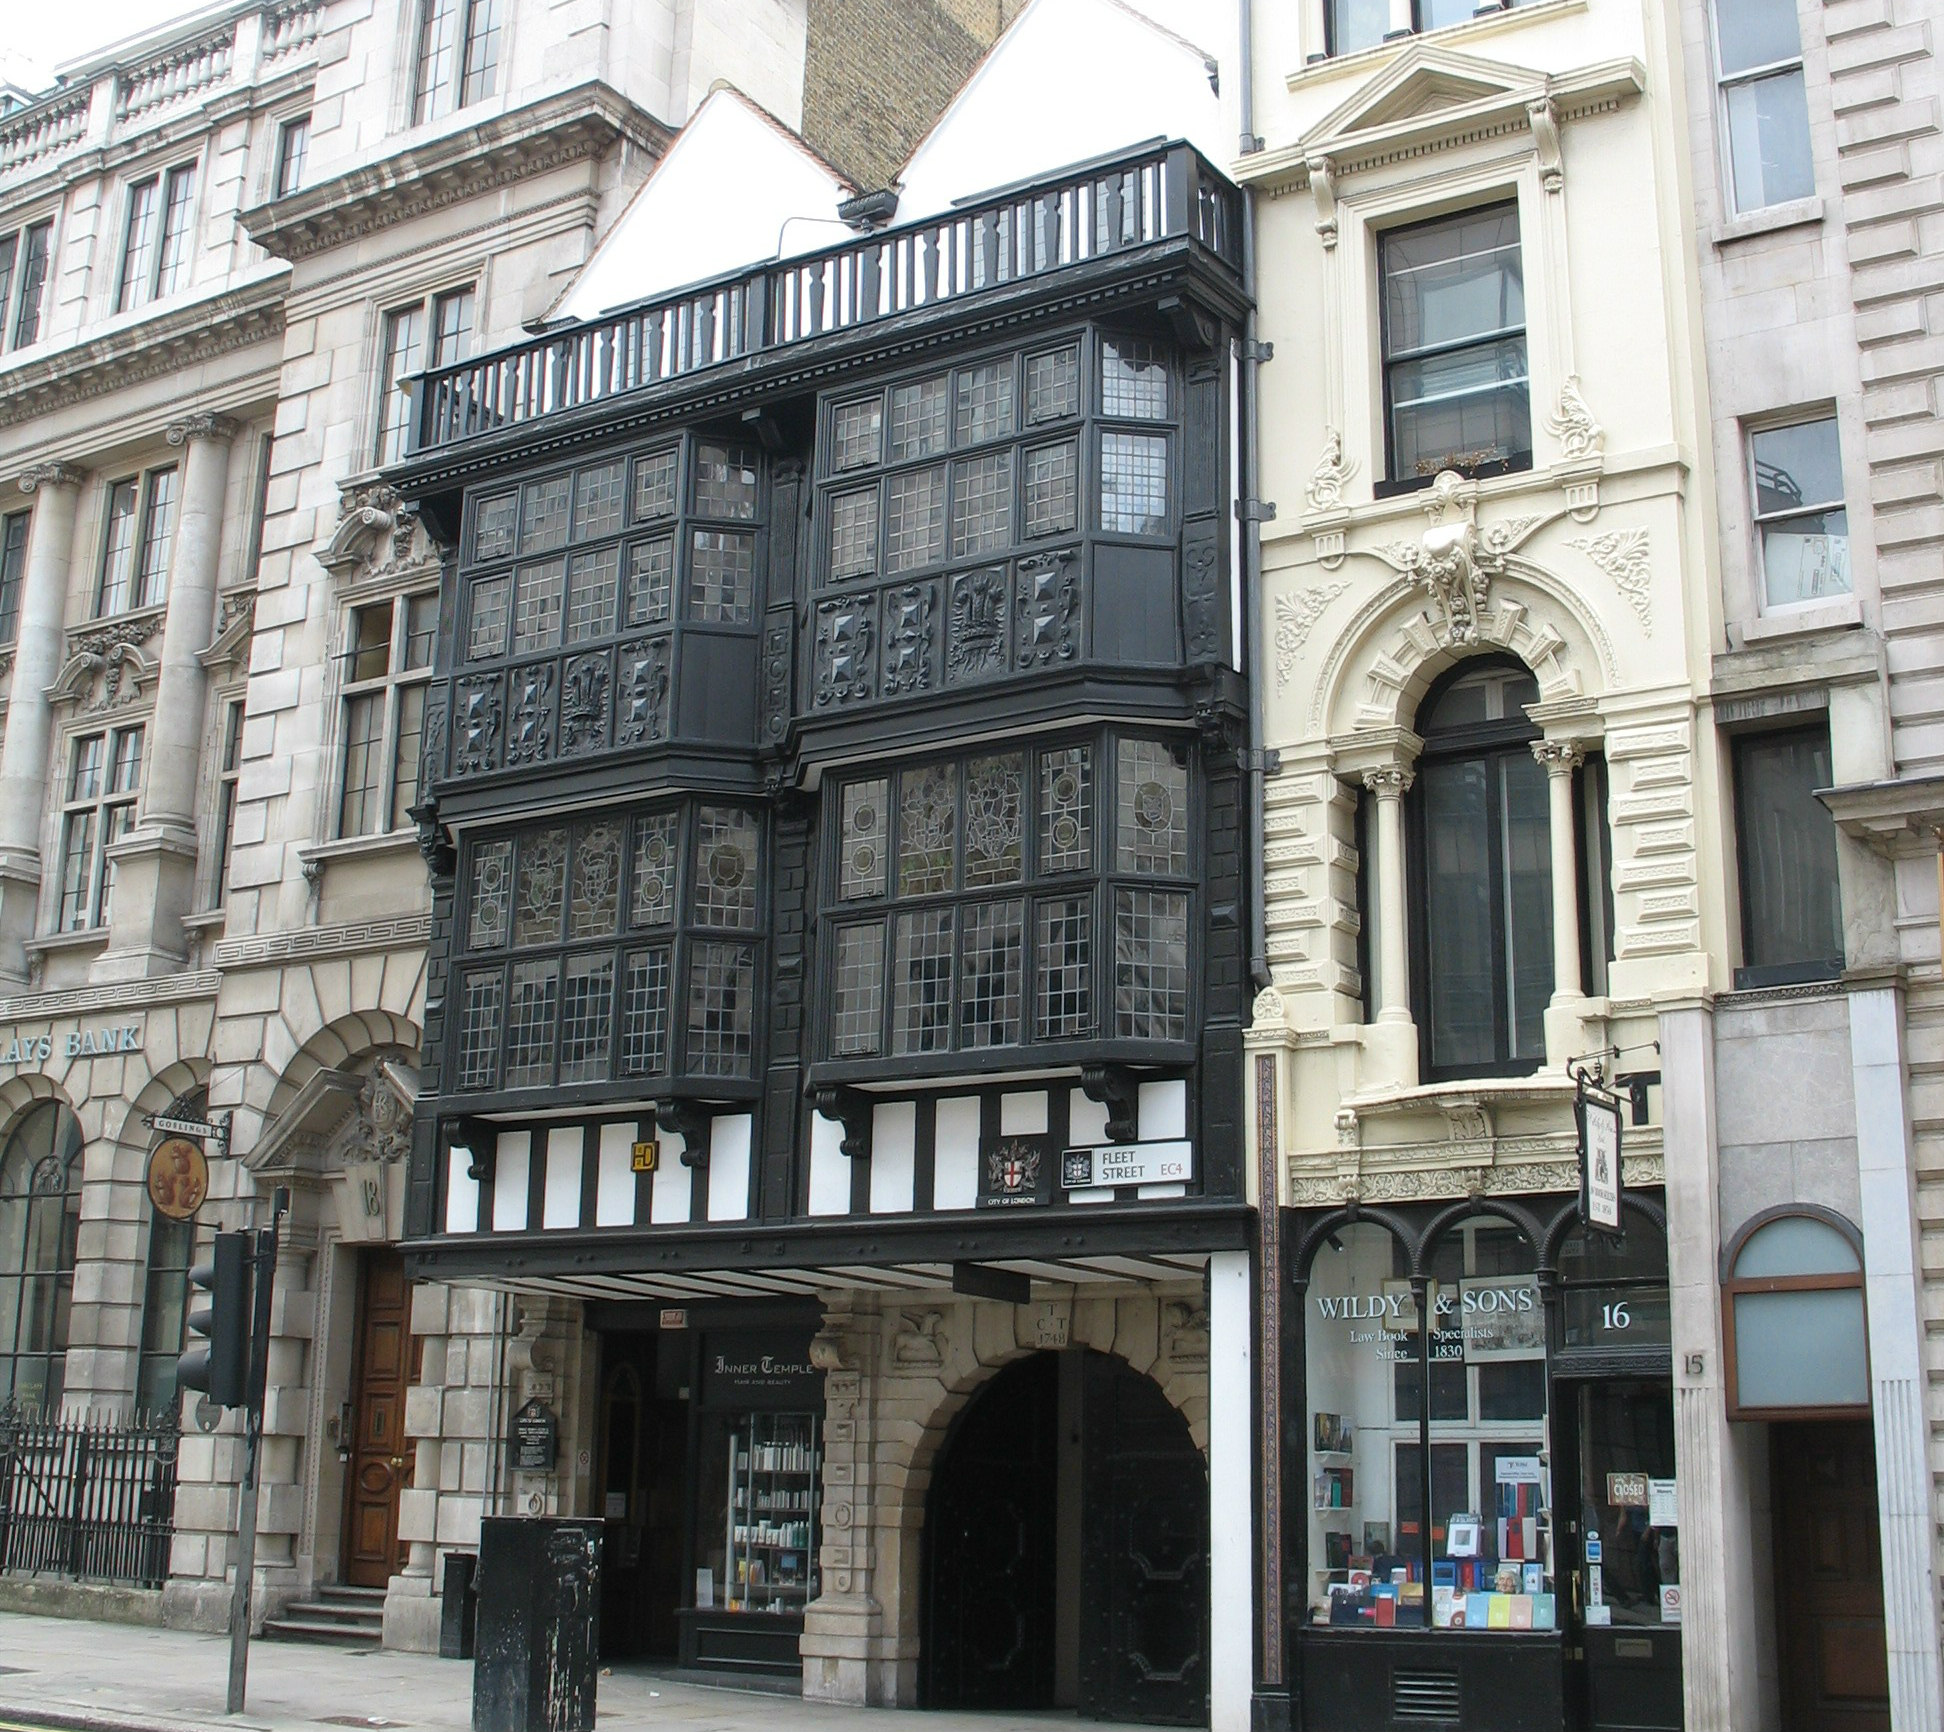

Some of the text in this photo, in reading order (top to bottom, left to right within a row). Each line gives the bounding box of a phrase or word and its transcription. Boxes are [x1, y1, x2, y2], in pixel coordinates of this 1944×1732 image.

[64, 1025, 140, 1058] BANK
[158, 1120, 208, 1136] GOSLINGS
[1102, 1150, 1136, 1165] FLEET
[1102, 1163, 1183, 1180] STREET EC4
[363, 1179, 380, 1217] 18
[1316, 1288, 1533, 1320] WILDY & SONS
[1602, 1301, 1630, 1330] 16
[1350, 1326, 1495, 1343] Law Book Specialists
[1376, 1344, 1463, 1360] Since 1830
[1683, 1354, 1704, 1375] 15
